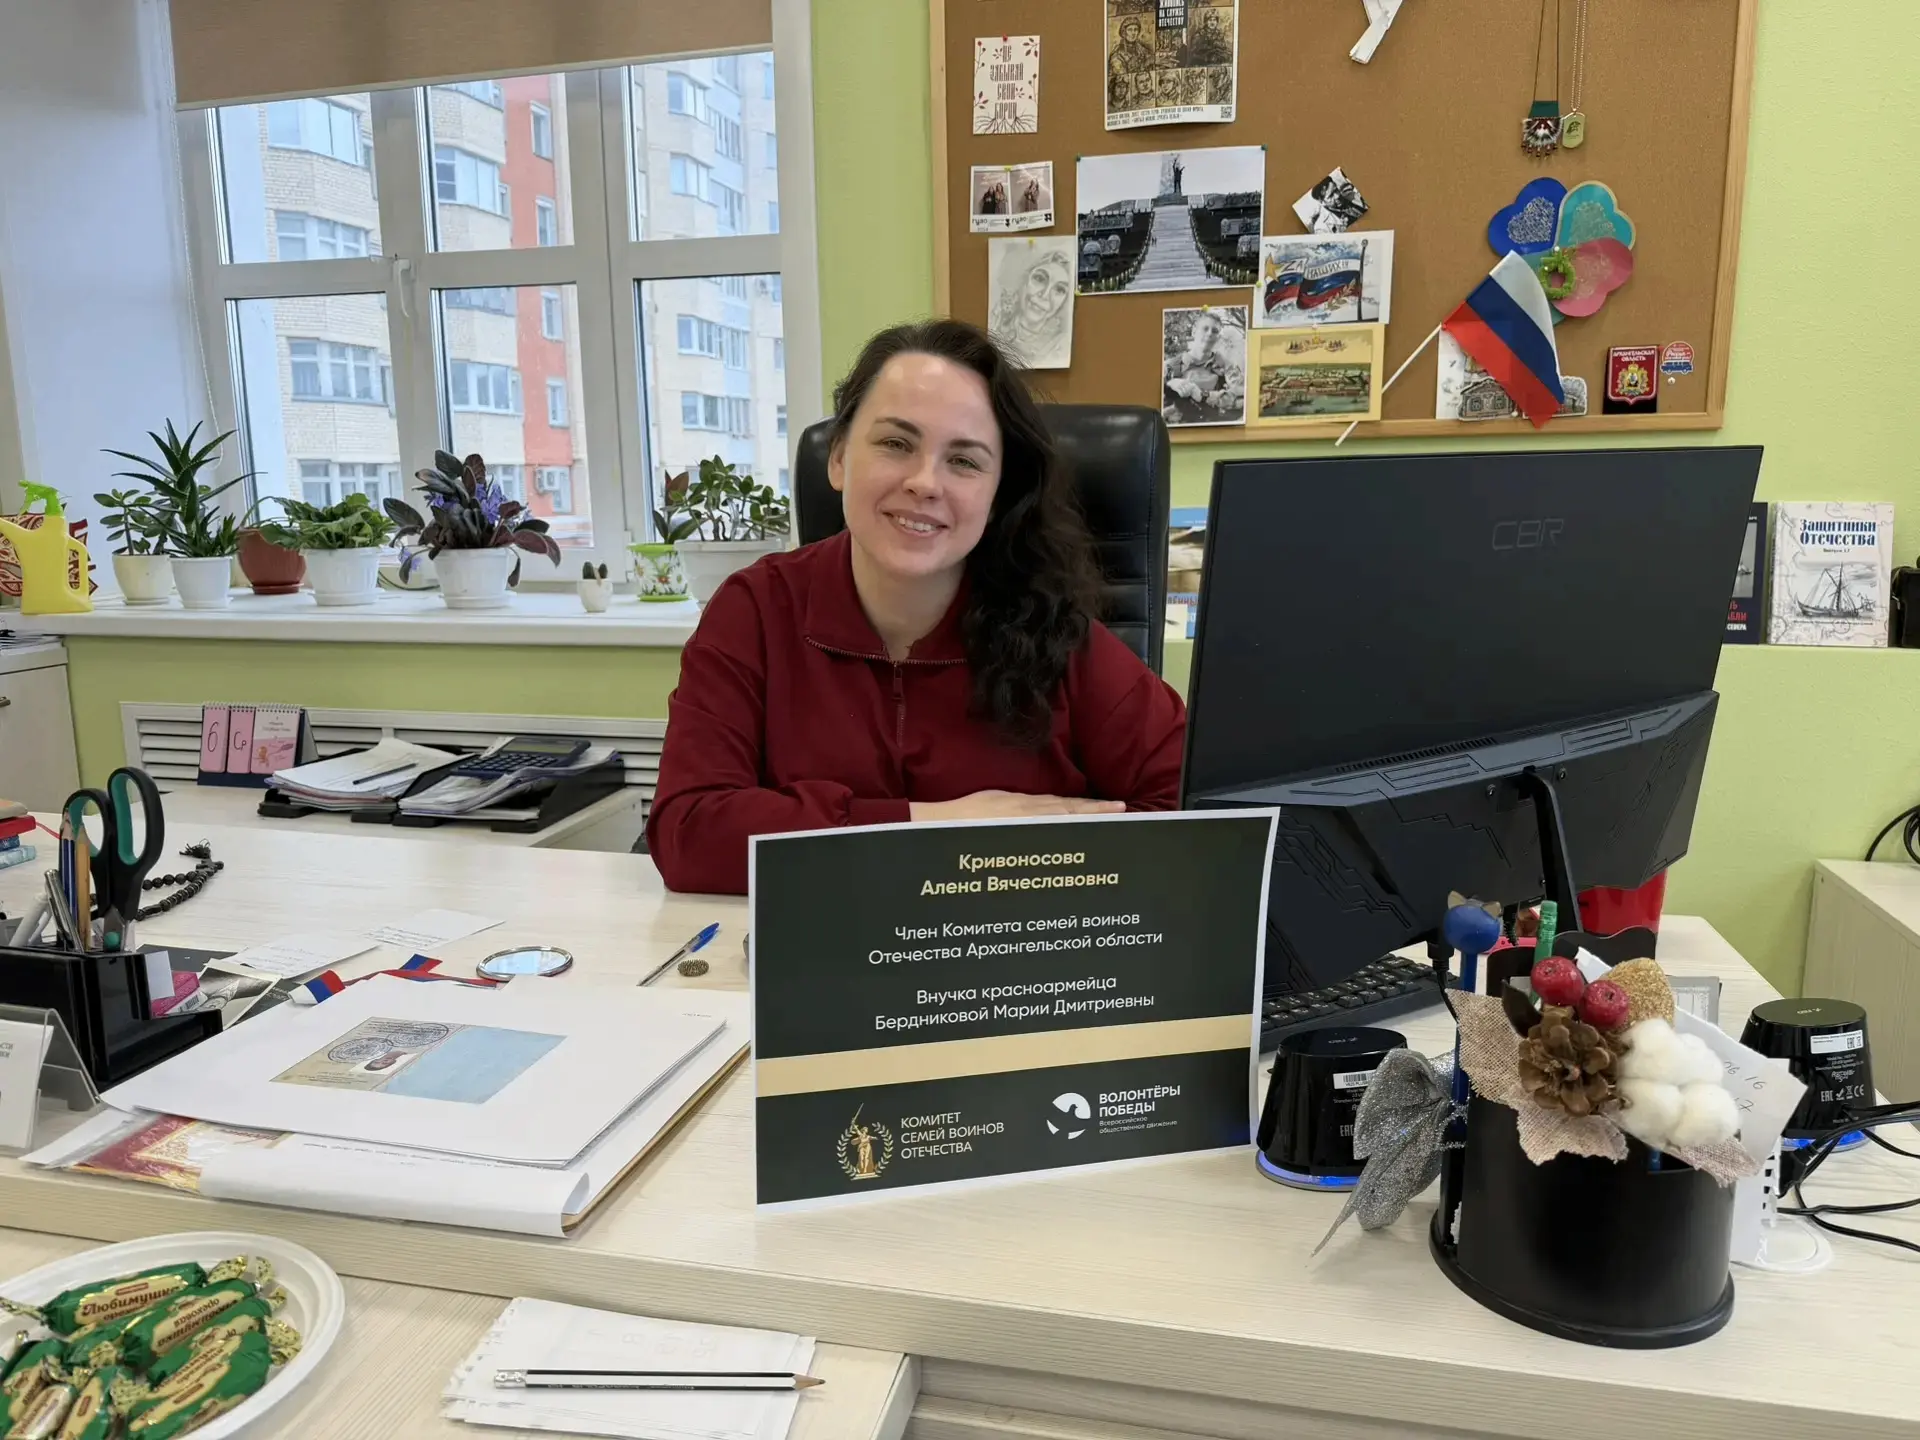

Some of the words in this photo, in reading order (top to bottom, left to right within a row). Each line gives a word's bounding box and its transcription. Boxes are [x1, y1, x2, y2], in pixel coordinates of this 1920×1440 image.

[1002, 45, 1012, 63] НЕ
[1492, 518, 1564, 551] CBR
[1800, 519, 1877, 534] Защитники
[1800, 531, 1876, 546] Отечества
[959, 852, 1086, 873] Кривоносова
[920, 879, 982, 896] Алена
[987, 872, 1119, 892] Вячеславовна
[895, 926, 938, 941] Член
[942, 921, 1022, 938] Комитета
[1026, 915, 1078, 932] семей
[1082, 912, 1141, 928] воинов
[868, 945, 962, 965] Отечества
[966, 935, 1092, 959] Архангельской
[1095, 931, 1163, 948] области
[916, 988, 977, 1006] Внучка
[981, 976, 1117, 1001] красноармейца
[875, 1006, 989, 1030] Бердниковой
[994, 1003, 1050, 1021] Марии
[1053, 994, 1155, 1016] Дмитриевны
[1099, 1085, 1181, 1104] ВОЛОНТЁРЫ
[1099, 1101, 1155, 1118] ПОБЕДЫ
[901, 1112, 961, 1129] КОМИТЕТ
[1099, 1116, 1148, 1127] Всероссийское
[1099, 1124, 1146, 1134] общественное
[1146, 1120, 1178, 1129] движение
[901, 1127, 945, 1144] СЕМЕЙ
[949, 1122, 1005, 1139] ВОИНОВ
[901, 1141, 973, 1160] ОТЕЧЕСТВА
